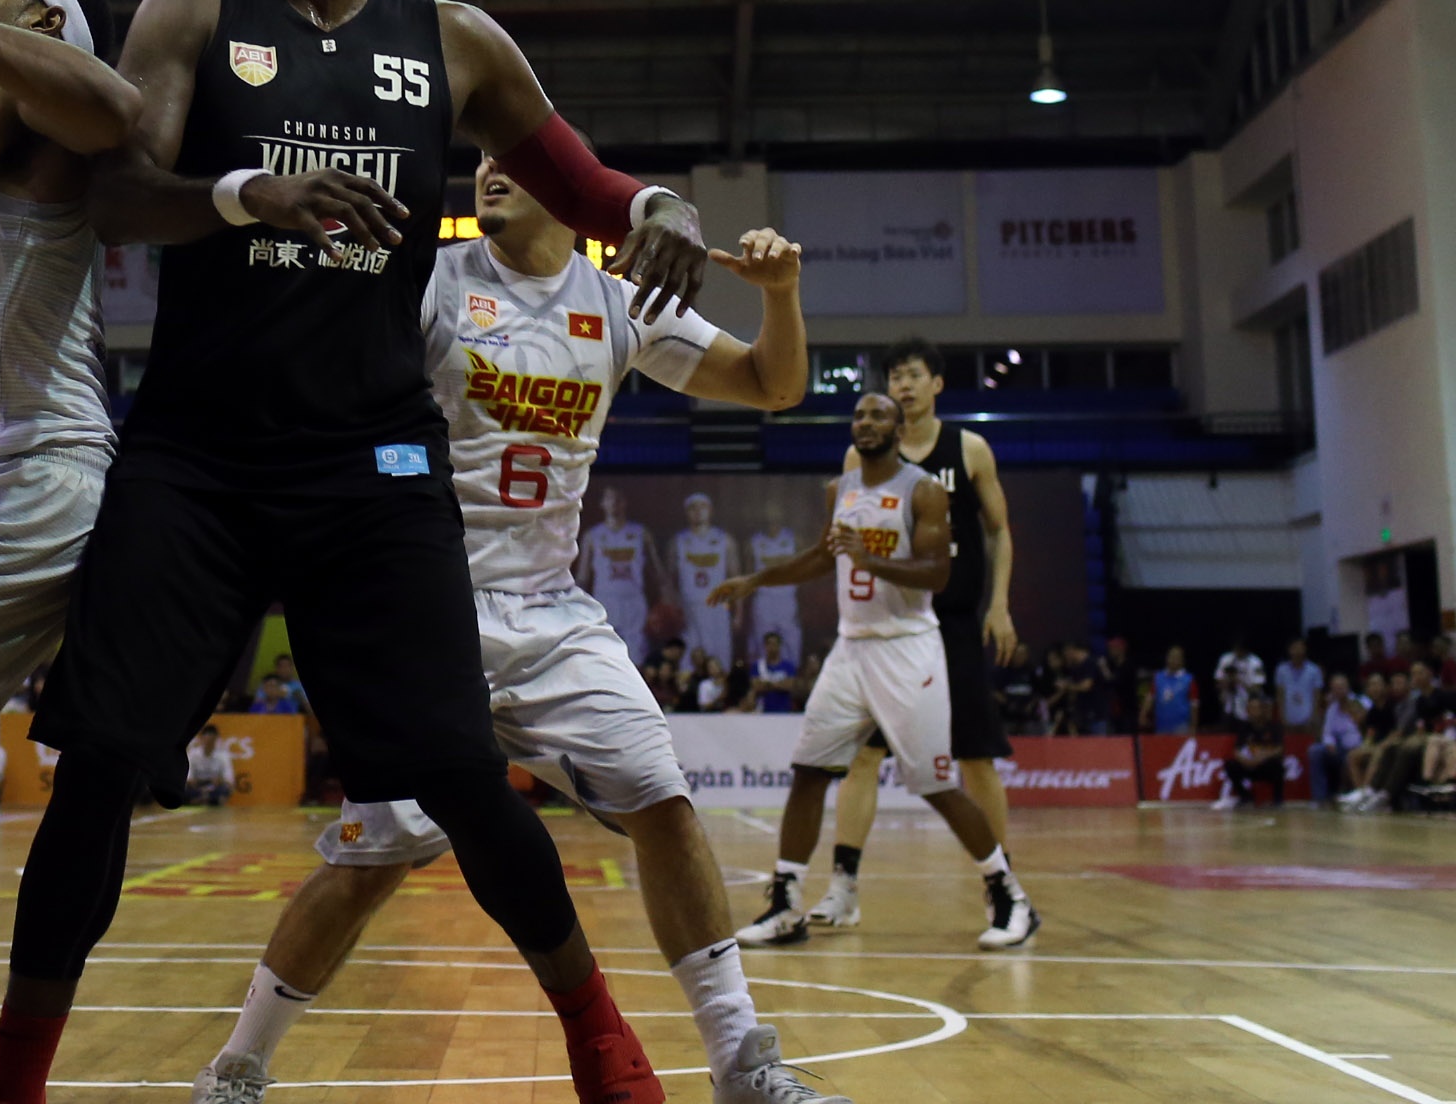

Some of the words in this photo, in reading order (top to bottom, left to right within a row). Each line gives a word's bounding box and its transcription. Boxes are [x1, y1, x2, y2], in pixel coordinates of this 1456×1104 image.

[236, 49, 272, 65] ABL
[373, 53, 431, 108] 55
[284, 120, 377, 142] CHONGSON
[471, 297, 496, 313] ABL
[465, 369, 602, 413] SAIGON
[487, 402, 593, 439] HEAT
[499, 443, 552, 508] 6
[848, 568, 875, 602] 9
